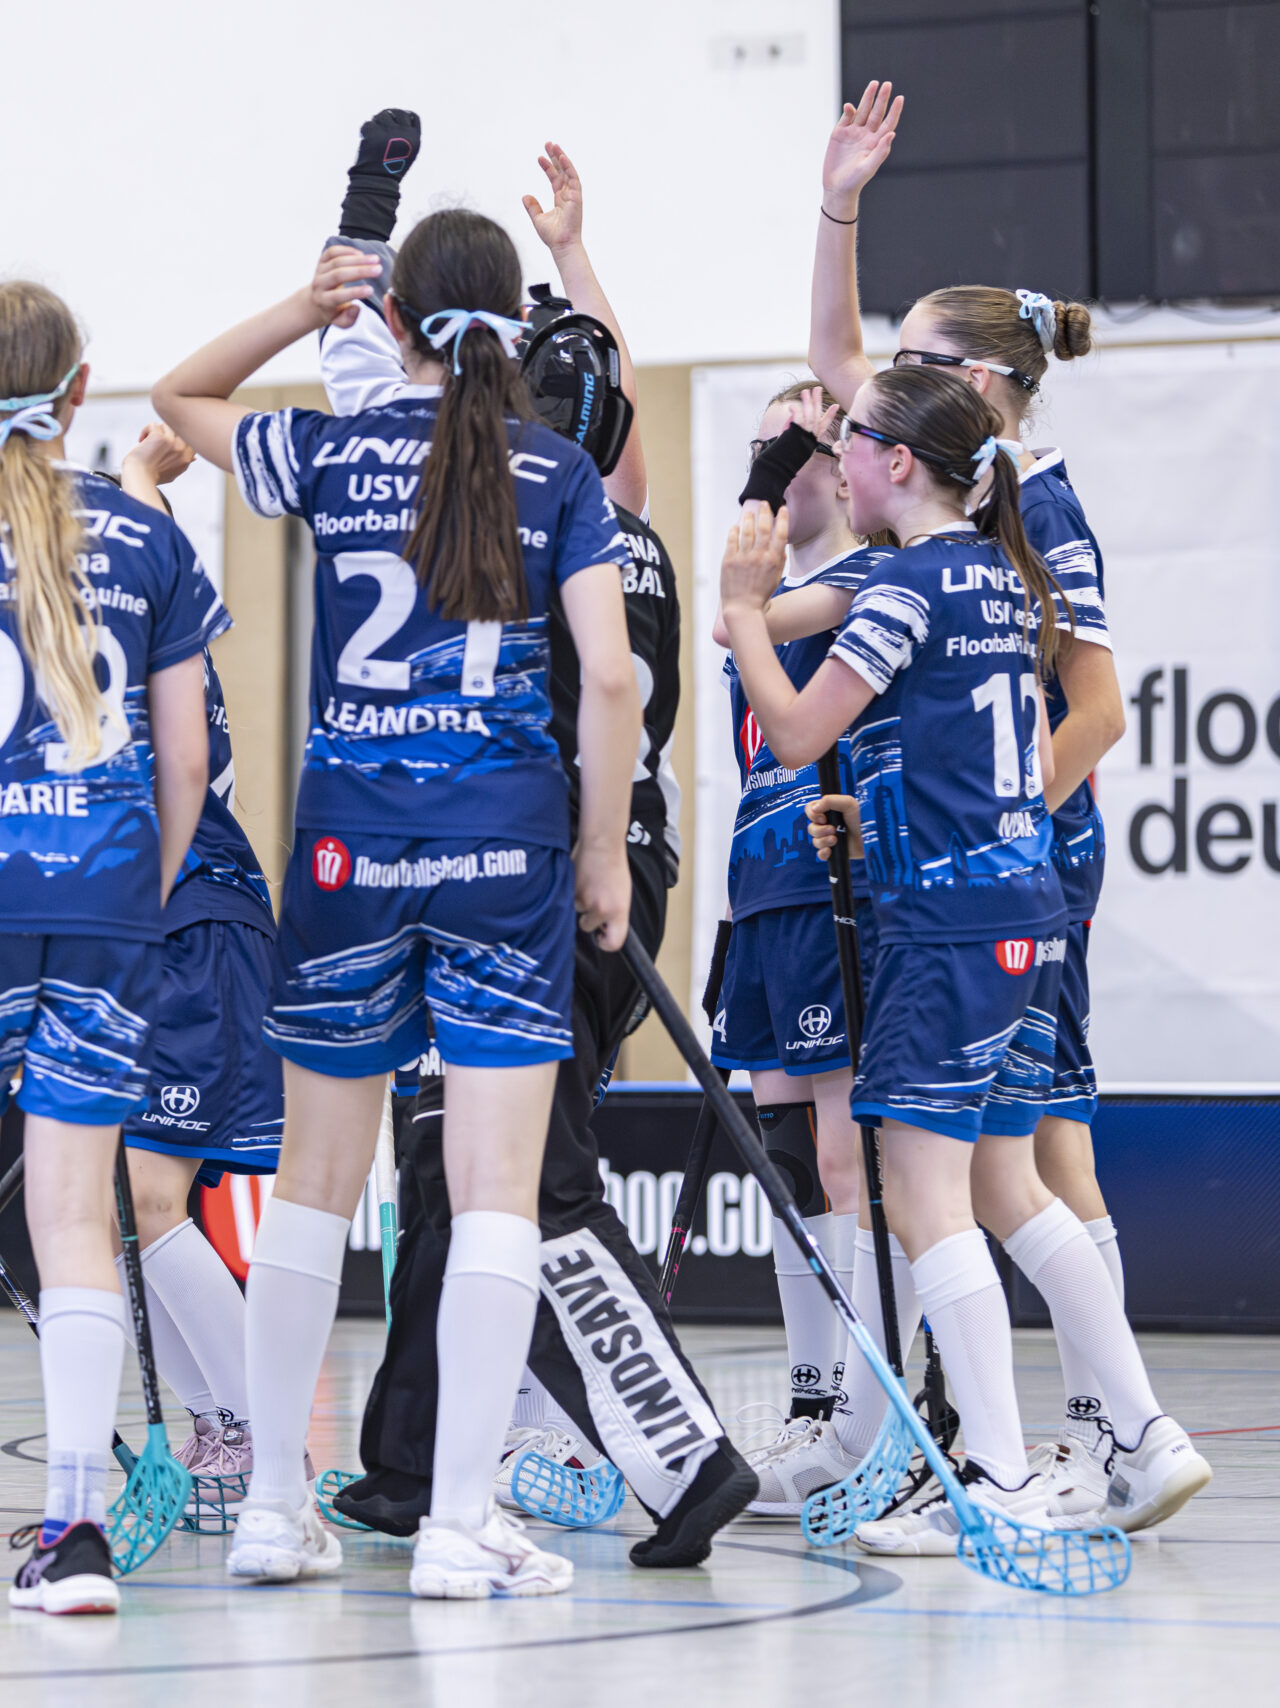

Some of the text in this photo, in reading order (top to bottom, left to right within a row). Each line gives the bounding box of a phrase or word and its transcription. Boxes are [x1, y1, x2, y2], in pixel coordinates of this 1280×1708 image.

[347, 474, 420, 501] USV
[1130, 667, 1280, 767] flo
[786, 1034, 846, 1050] UNIHOC
[141, 1111, 211, 1132] UNIHOC
